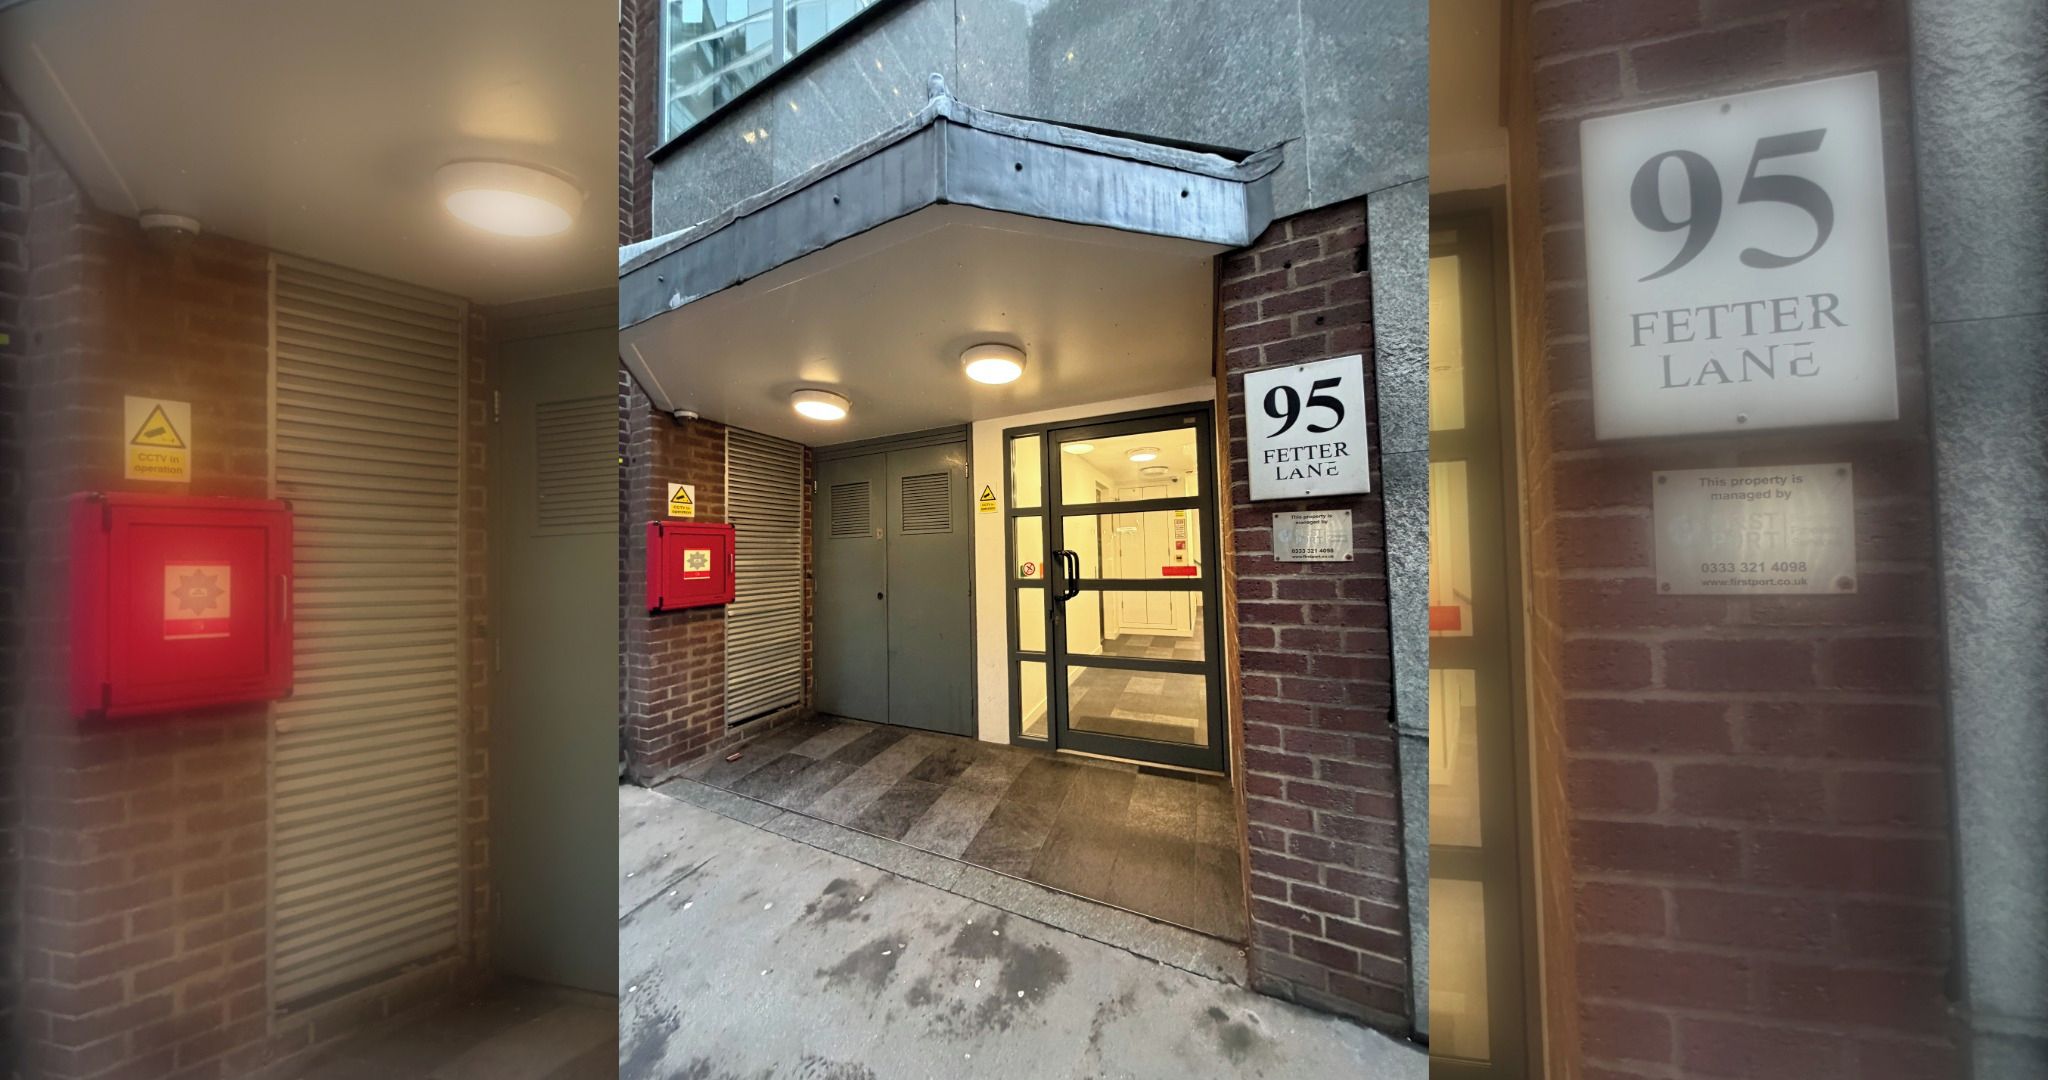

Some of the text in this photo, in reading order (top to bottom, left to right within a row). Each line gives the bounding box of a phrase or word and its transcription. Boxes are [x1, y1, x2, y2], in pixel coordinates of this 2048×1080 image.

[1629, 127, 1835, 283] 95
[1628, 292, 1849, 348] FETTER
[1658, 341, 1821, 389] LANE
[1263, 376, 1345, 439] 95
[137, 452, 180, 464] CCTV in
[1263, 441, 1350, 464] FETTER
[133, 464, 184, 475] operation
[1275, 461, 1340, 481] LANE
[1699, 473, 1804, 488] This property is
[1711, 488, 1792, 502] managed by
[1700, 561, 1808, 573] 0333 321 4098
[1701, 576, 1808, 587] www.firstport.co.uk
